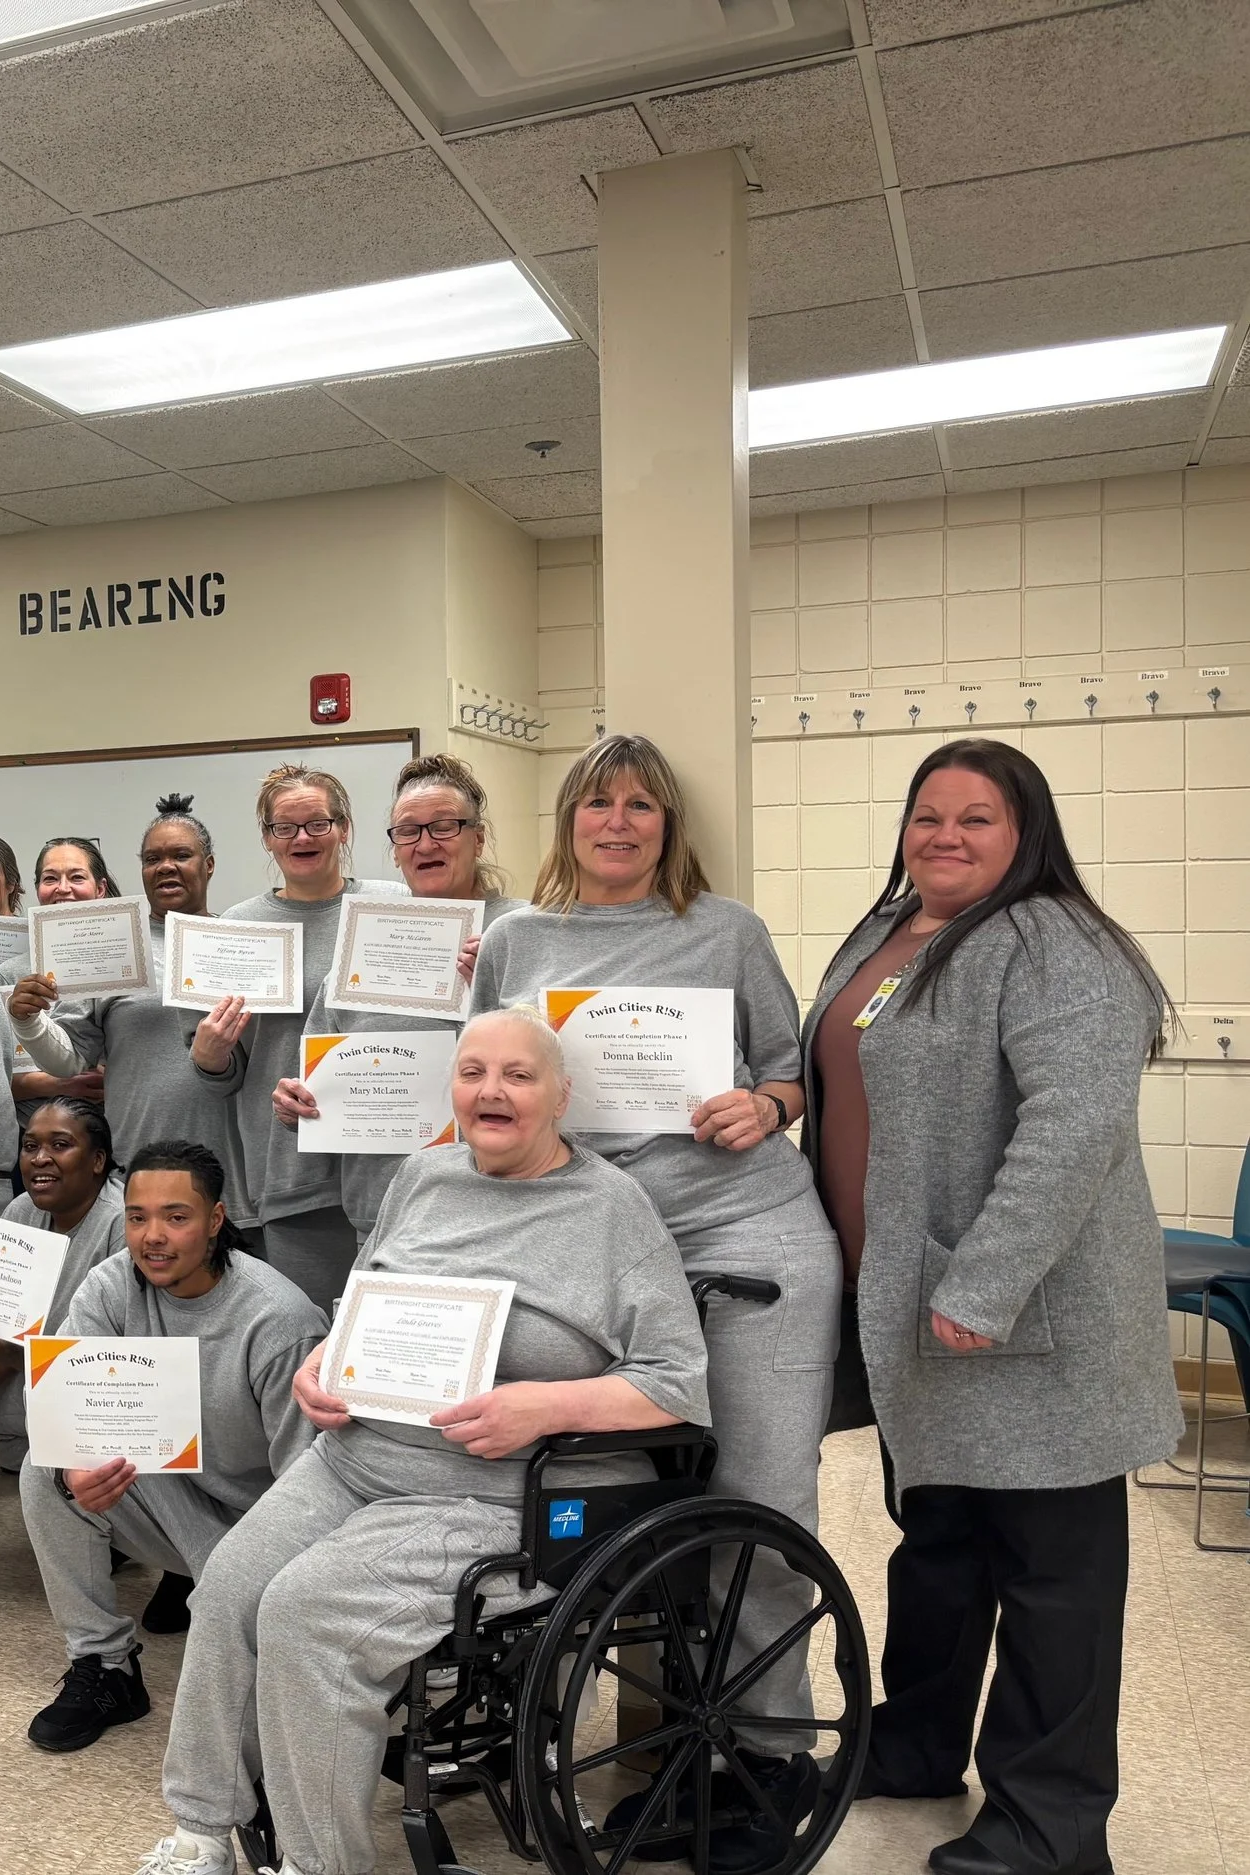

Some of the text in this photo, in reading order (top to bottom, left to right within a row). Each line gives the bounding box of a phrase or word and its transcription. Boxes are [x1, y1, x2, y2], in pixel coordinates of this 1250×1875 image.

[19, 573, 226, 635] BEARING
[587, 1002, 685, 1021] Twin Cities R!SE
[337, 1045, 417, 1060] Twin Cities R!SE
[603, 1051, 673, 1061] Donna Becklin
[350, 1087, 409, 1096] Mary McLaren
[385, 1299, 463, 1311] BIRTHRIGHT CERTIFICATE
[68, 1352, 156, 1369] Twin Cities R!SE
[85, 1398, 143, 1409] Navier Argue
